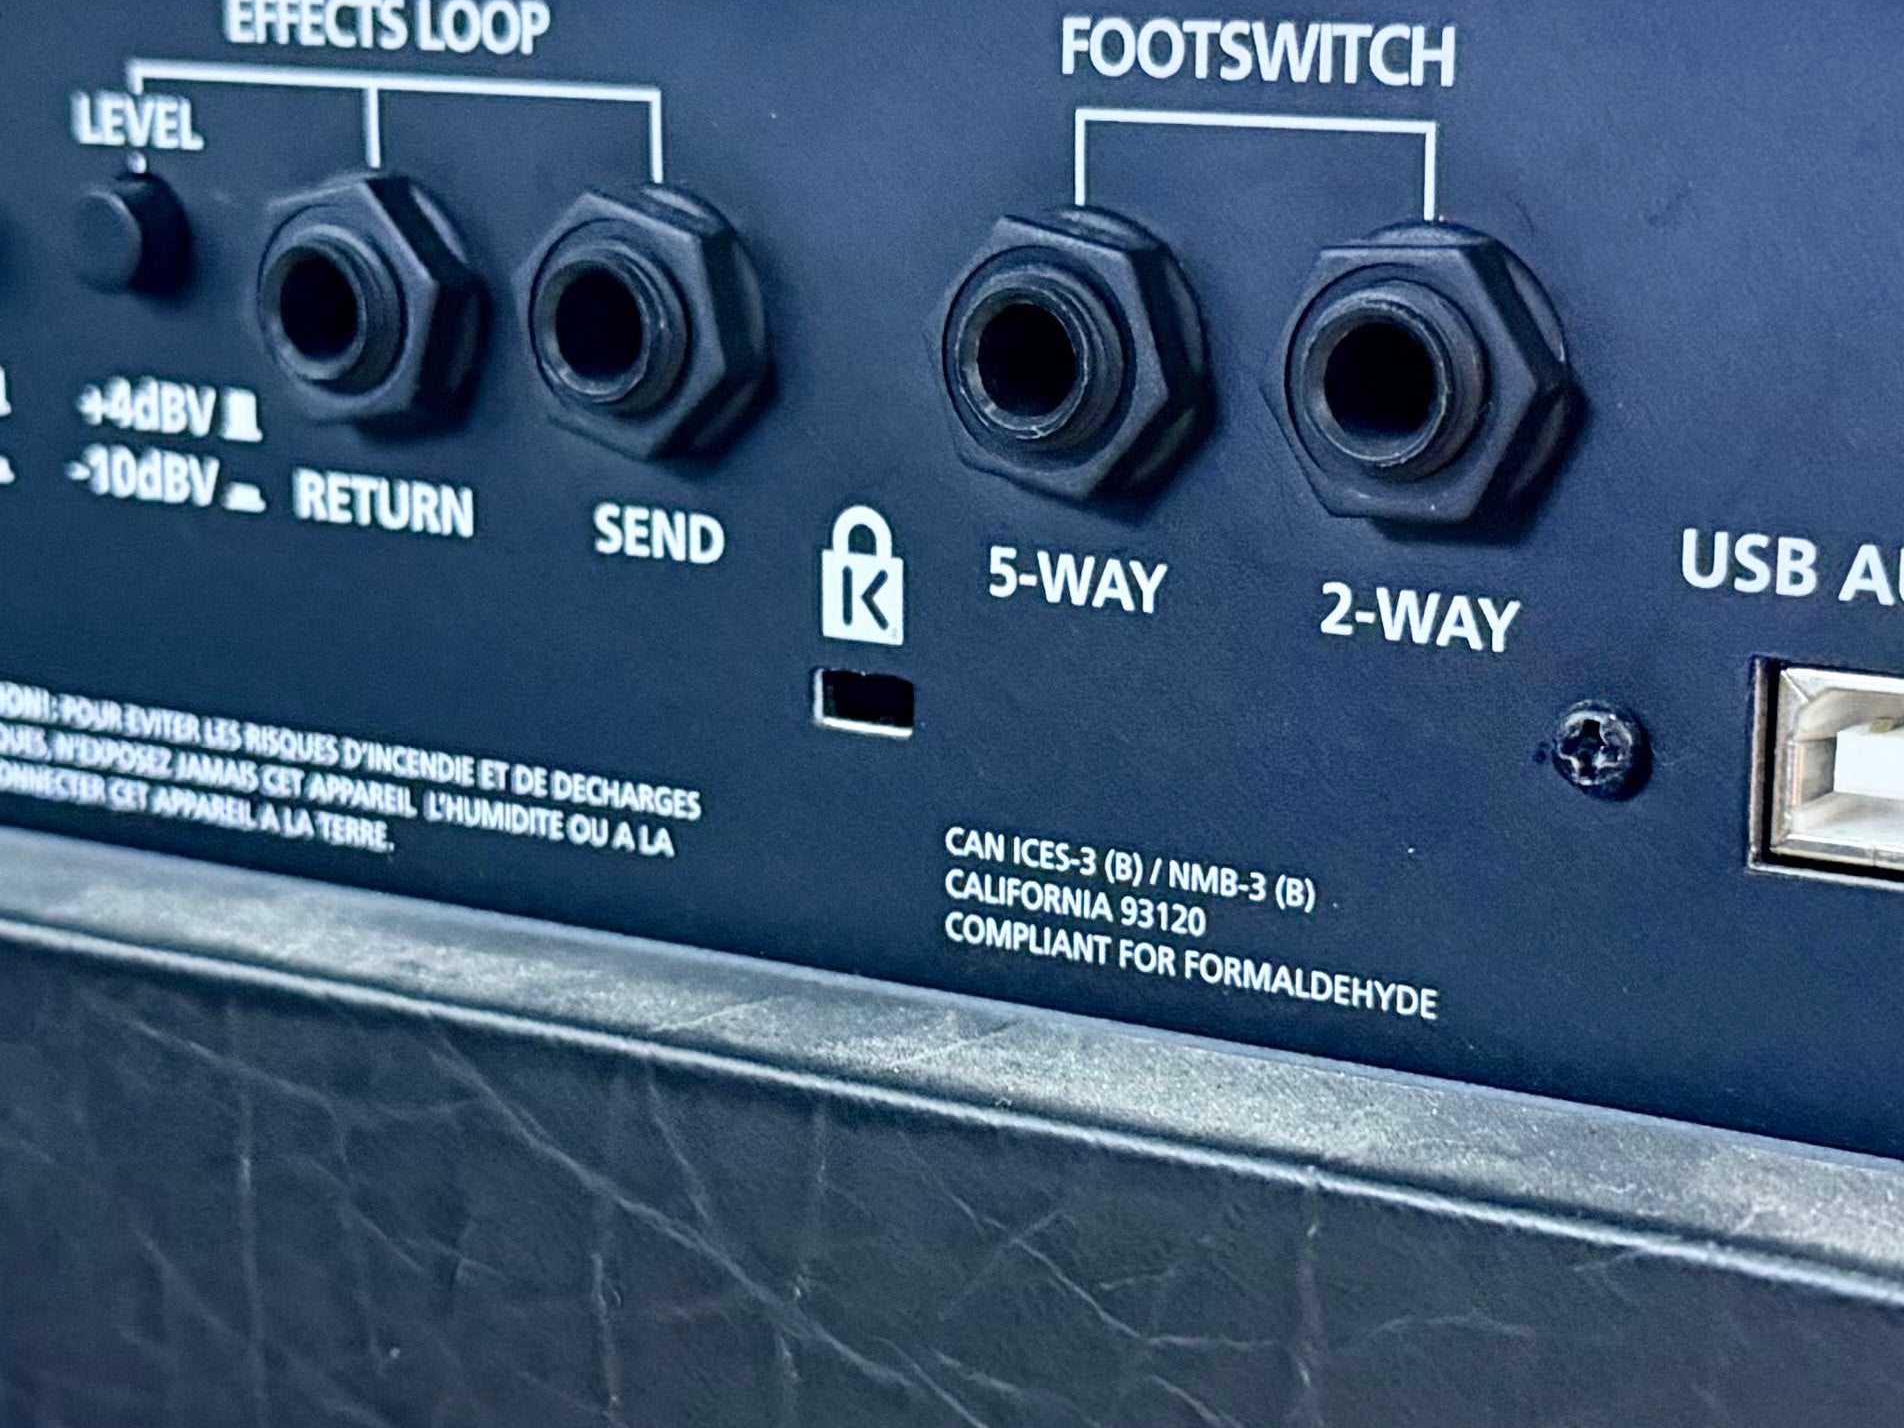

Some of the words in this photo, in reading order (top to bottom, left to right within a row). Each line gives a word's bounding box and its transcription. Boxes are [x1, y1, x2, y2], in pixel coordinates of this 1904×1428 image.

[1061, 15, 1458, 89] FOOTSWITCH
[70, 90, 205, 152] LEVEL
[77, 375, 217, 438] +4dBV
[64, 444, 220, 508] -10dBV
[295, 466, 476, 540] RETURN
[591, 501, 725, 567] SEND
[1681, 526, 1819, 597] USB
[988, 545, 1169, 616] 5-WAY
[1319, 581, 1522, 654] 2-WAY
[59, 692, 123, 729] POUR
[122, 702, 201, 744] EVITER
[203, 715, 243, 752] LES
[245, 721, 339, 766] RISQUES
[341, 735, 475, 787] D'INCENDIE
[476, 757, 511, 791] ET
[510, 763, 548, 799] DE
[549, 768, 703, 821] DECHARGES
[51, 729, 173, 779] N'EXPOSEZ
[175, 750, 260, 794] JAMAIS
[259, 763, 306, 800] CET
[304, 772, 419, 819] APPAREIL
[422, 788, 565, 843] L'HUMIDITE
[565, 812, 609, 848] OU
[611, 821, 636, 853] A
[637, 824, 676, 858] LA
[106, 775, 150, 813] CET
[149, 784, 258, 832] APPAREIL
[257, 801, 281, 834] A
[279, 806, 315, 839] LA
[313, 810, 396, 854] TERRE.
[944, 826, 1005, 862] CAN
[1012, 835, 1097, 876] ICES-3
[1103, 848, 1144, 888] (B)
[1148, 856, 1163, 887] /
[1168, 859, 1267, 903] NMB-3
[1275, 873, 1317, 914] (B)
[944, 867, 1114, 923] CALIFORNIA
[1119, 895, 1207, 938] 93120
[944, 910, 1113, 966] COMPLIANT
[1117, 938, 1177, 978] FOR
[1184, 948, 1440, 1021] FORMALDEHYDE
